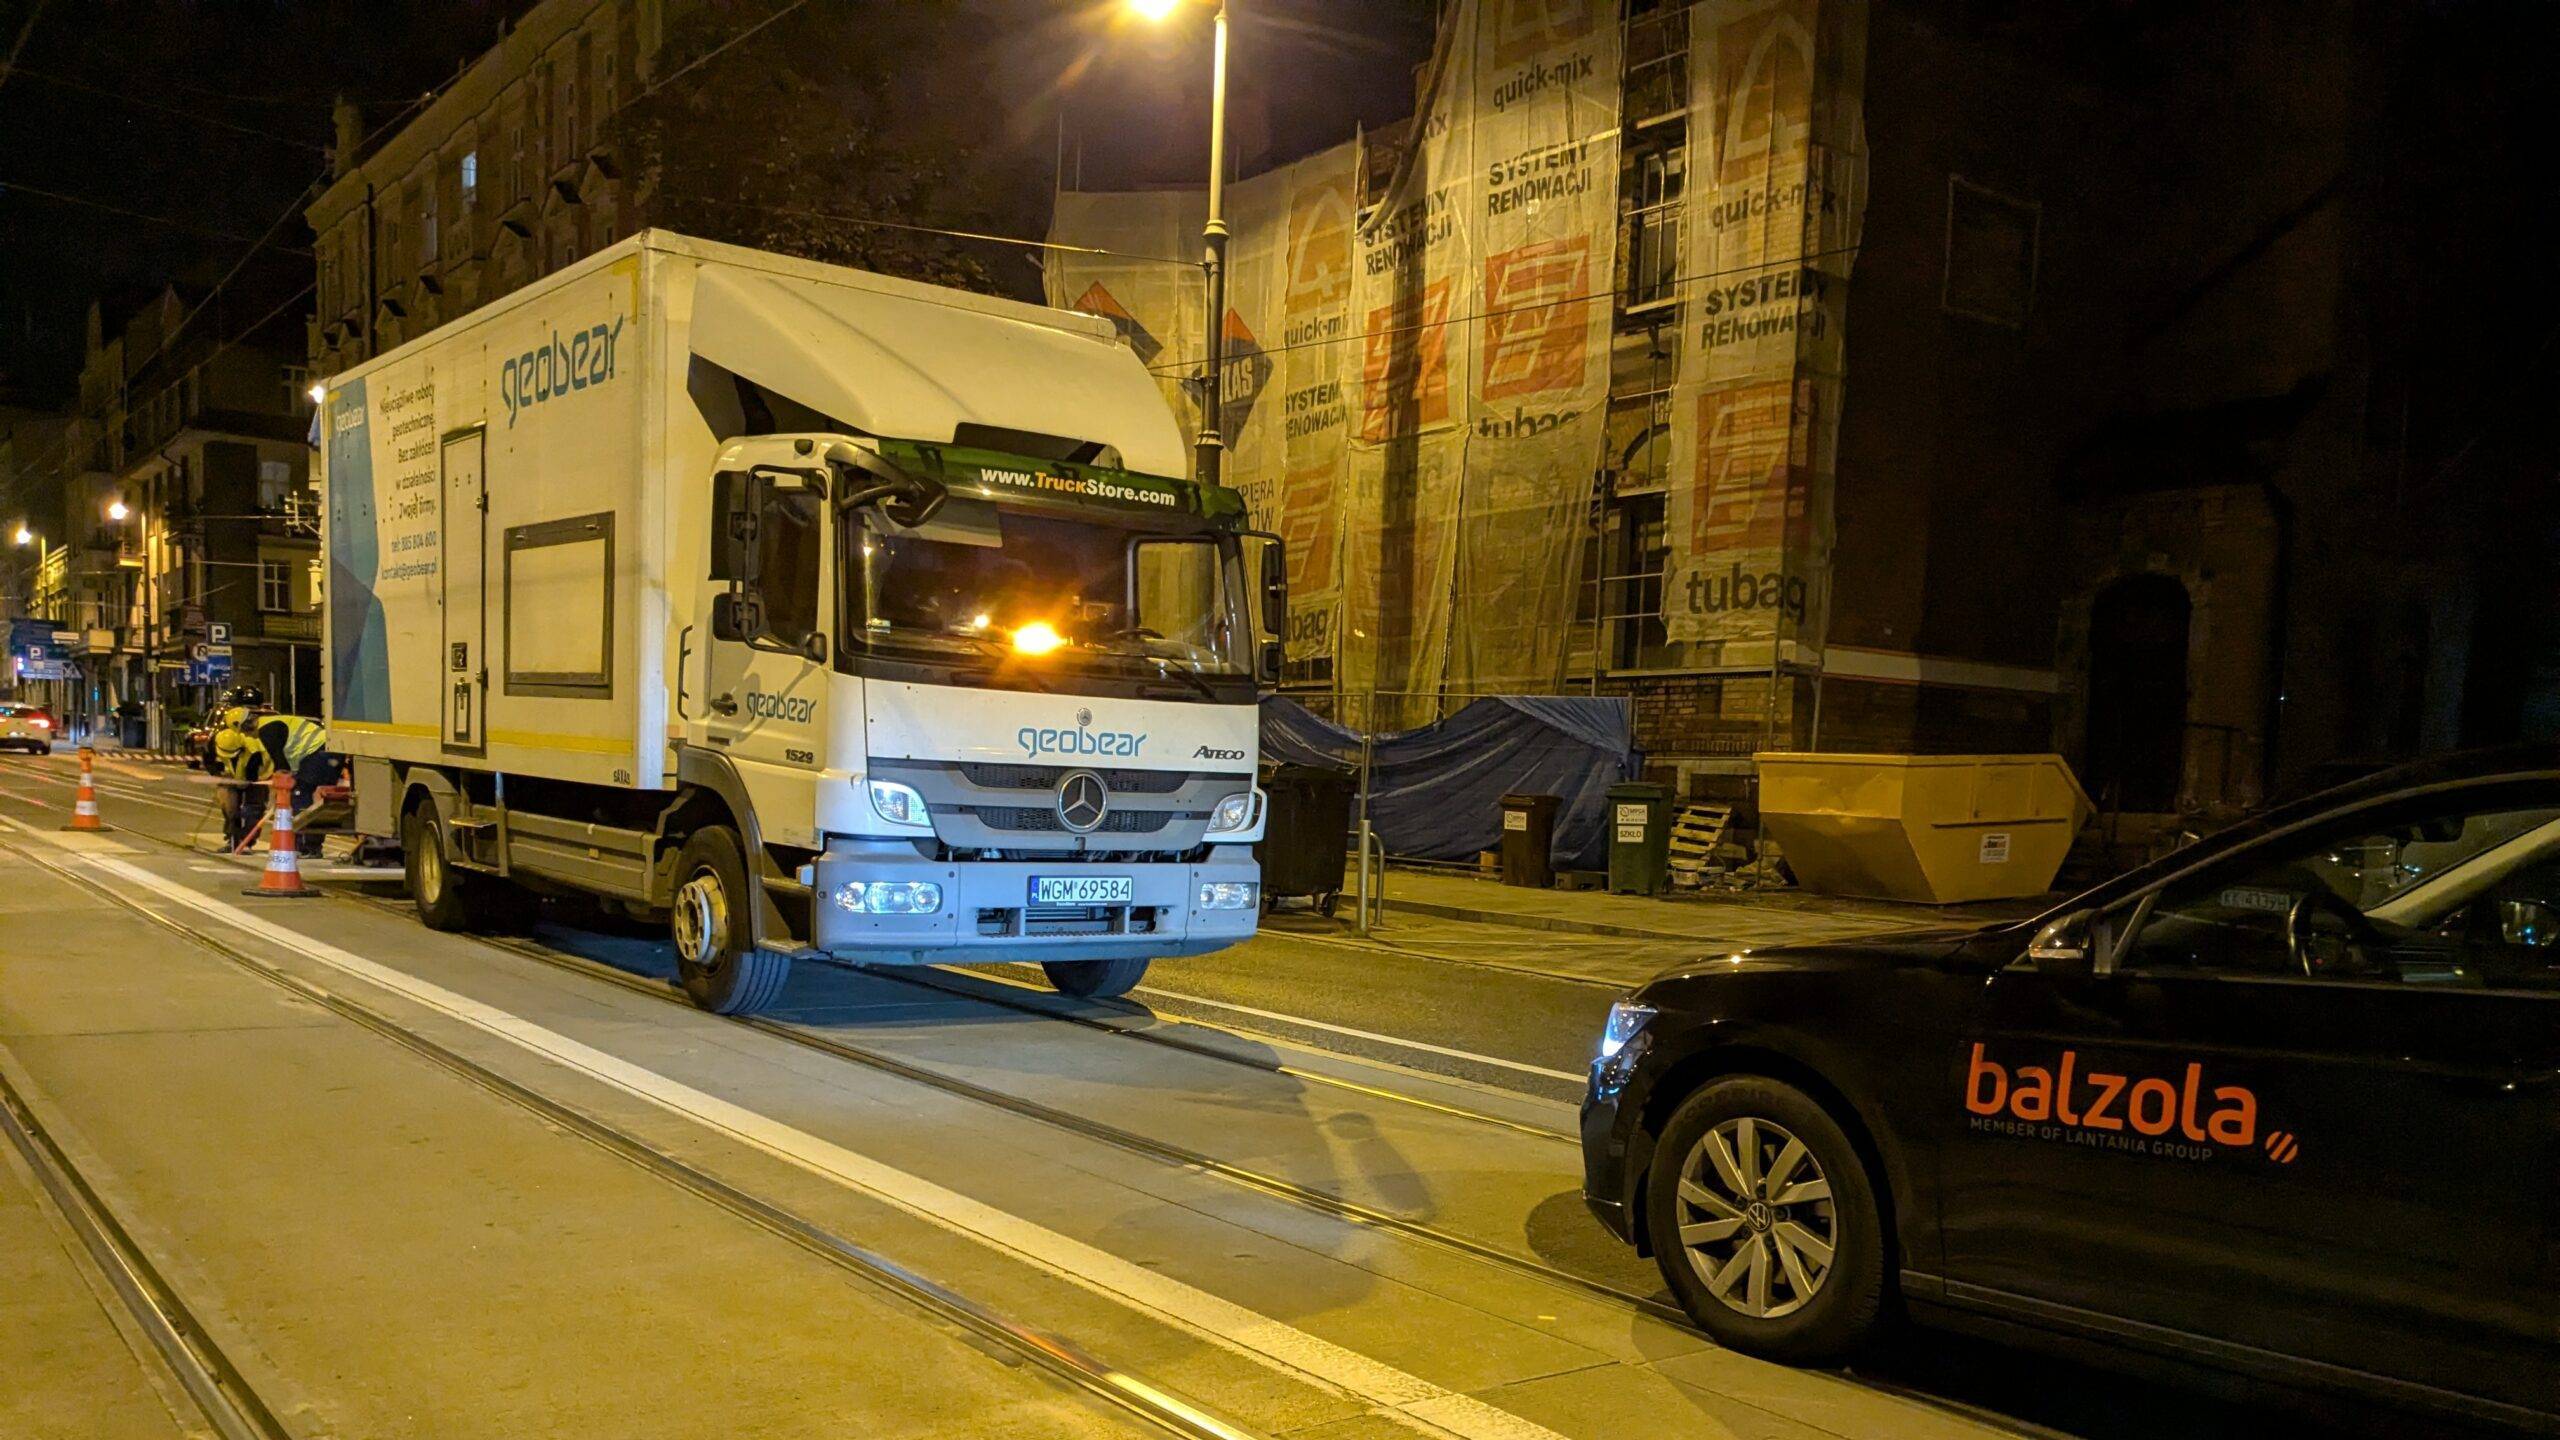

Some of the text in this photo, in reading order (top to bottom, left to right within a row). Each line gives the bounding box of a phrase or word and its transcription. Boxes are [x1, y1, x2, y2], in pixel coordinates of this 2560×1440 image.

[1494, 53, 1594, 113] quick-mix
[1489, 142, 1588, 186] SYSTEMY
[1488, 167, 1592, 217] RENOWACJI
[502, 312, 623, 430] geobear
[1286, 379, 1344, 416] SYSTEM
[1479, 406, 1581, 437] tuba
[980, 468, 1176, 506] www.TruckStore.com
[1686, 562, 1807, 626] tubag
[211, 624, 226, 643] P
[747, 690, 817, 724] geobear
[785, 748, 814, 764] 1529
[1018, 726, 1147, 759] geobear
[1041, 880, 1131, 900] WGM 69584
[1966, 1042, 2258, 1146] balzola
[1970, 1117, 2214, 1161] MEMBER OF LANTANIA GROUP
